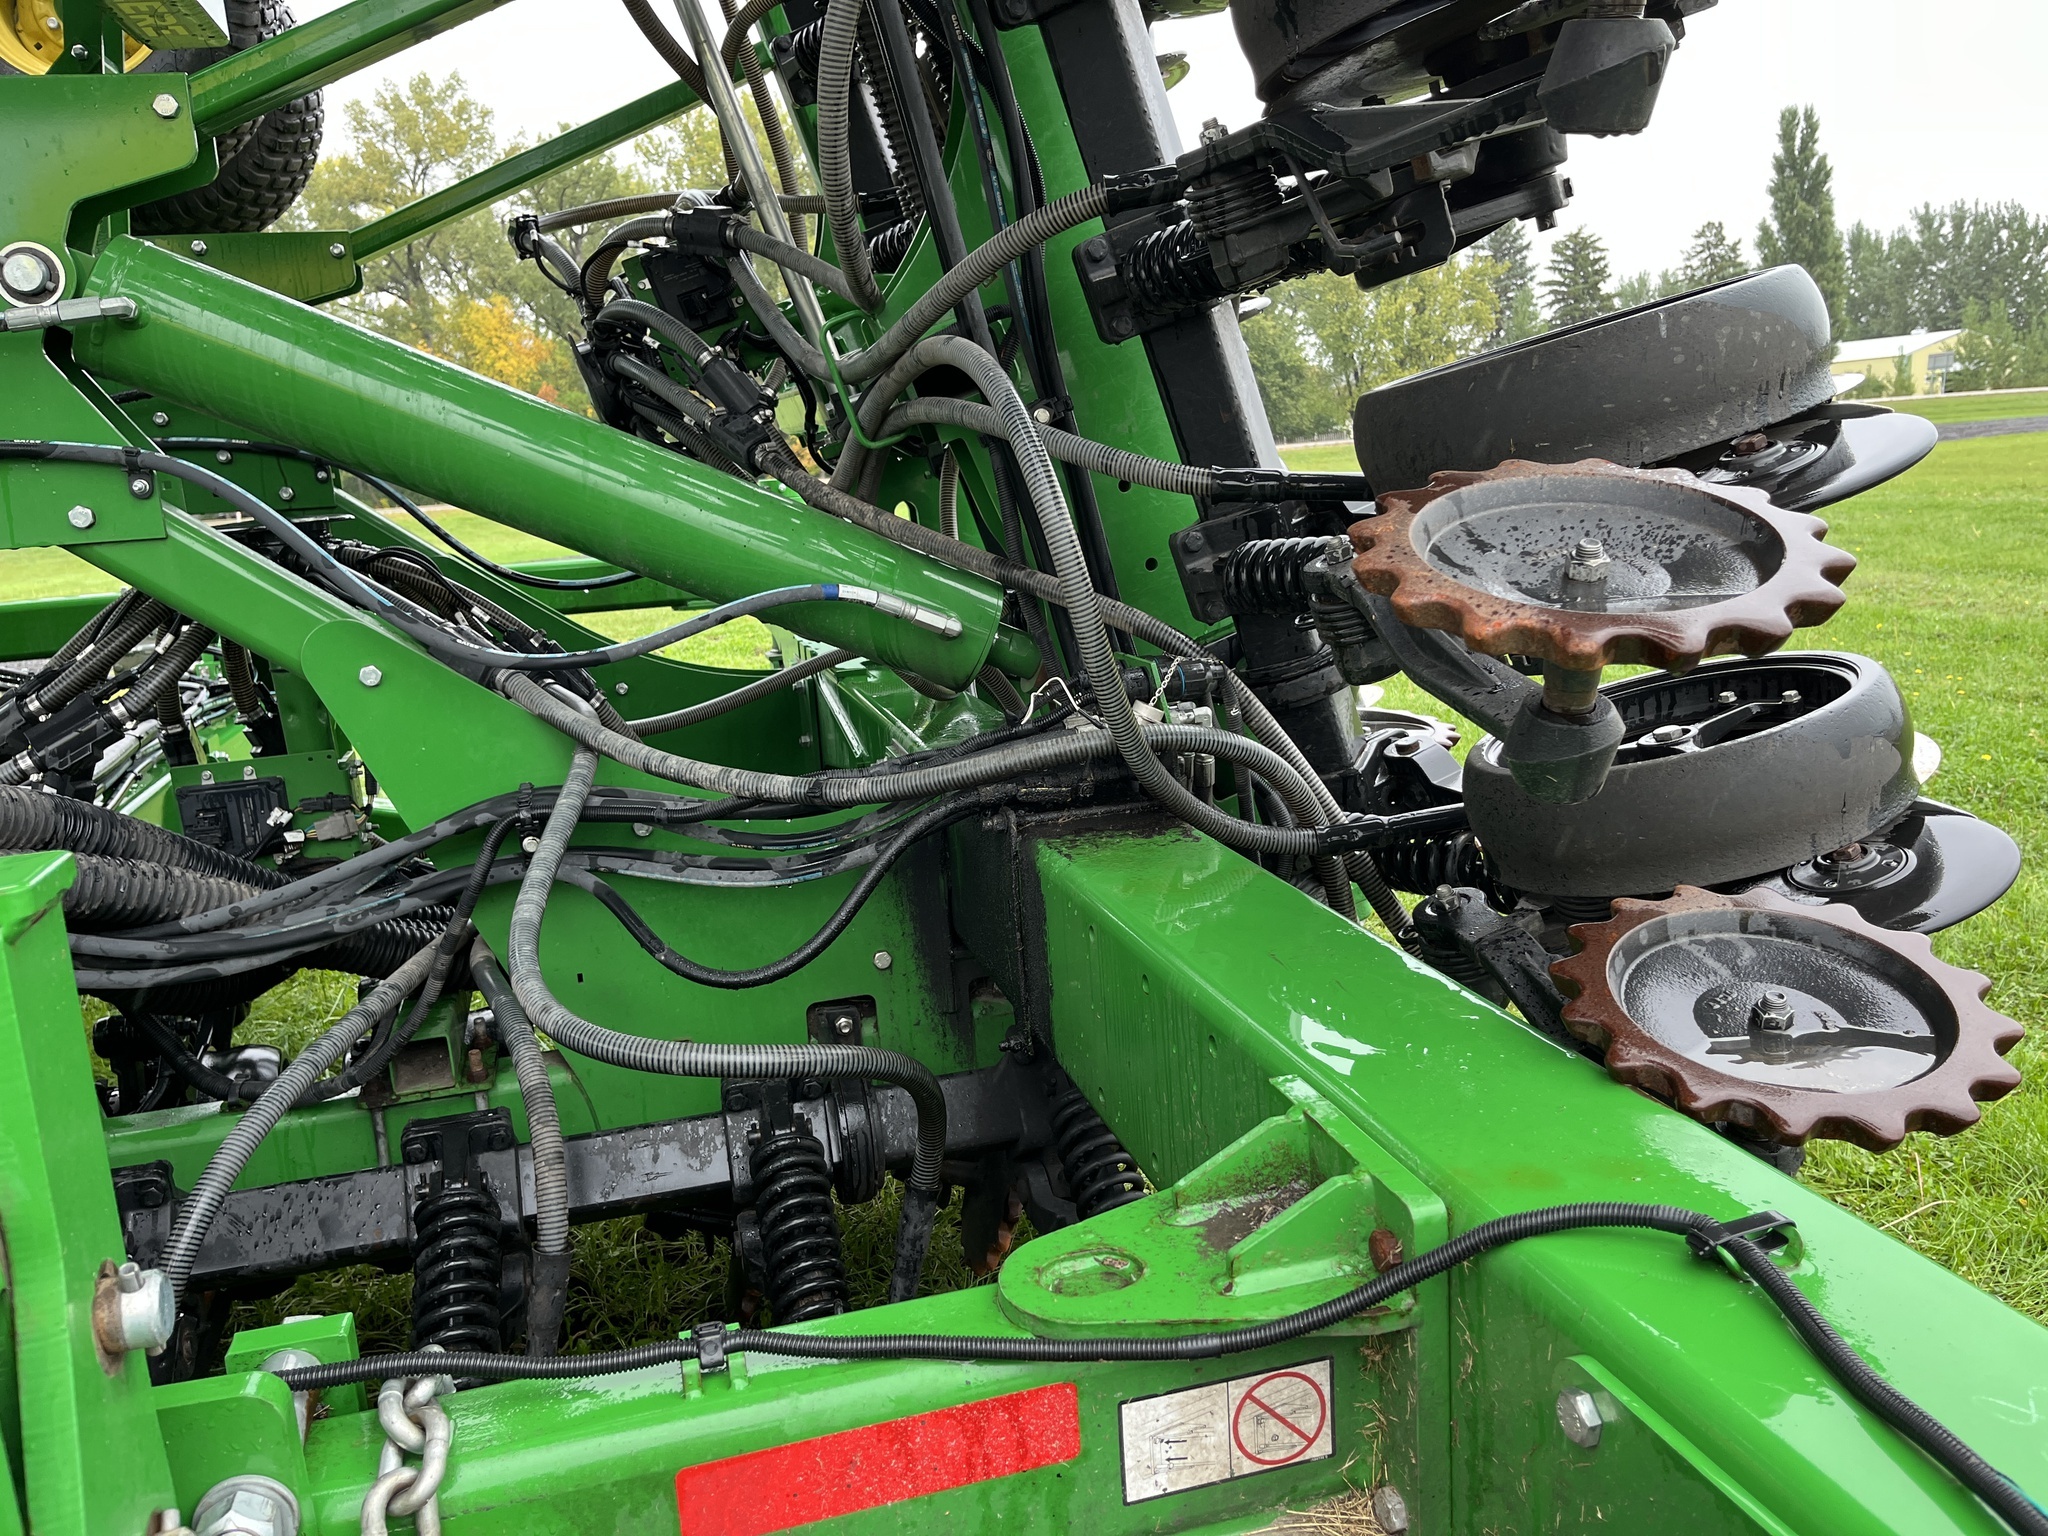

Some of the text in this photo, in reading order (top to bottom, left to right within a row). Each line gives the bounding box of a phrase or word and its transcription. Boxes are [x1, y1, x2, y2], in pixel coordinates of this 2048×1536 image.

[115, 0, 189, 37] ERE
[951, 14, 963, 41] GATES
[456, 639, 480, 649] GATES
